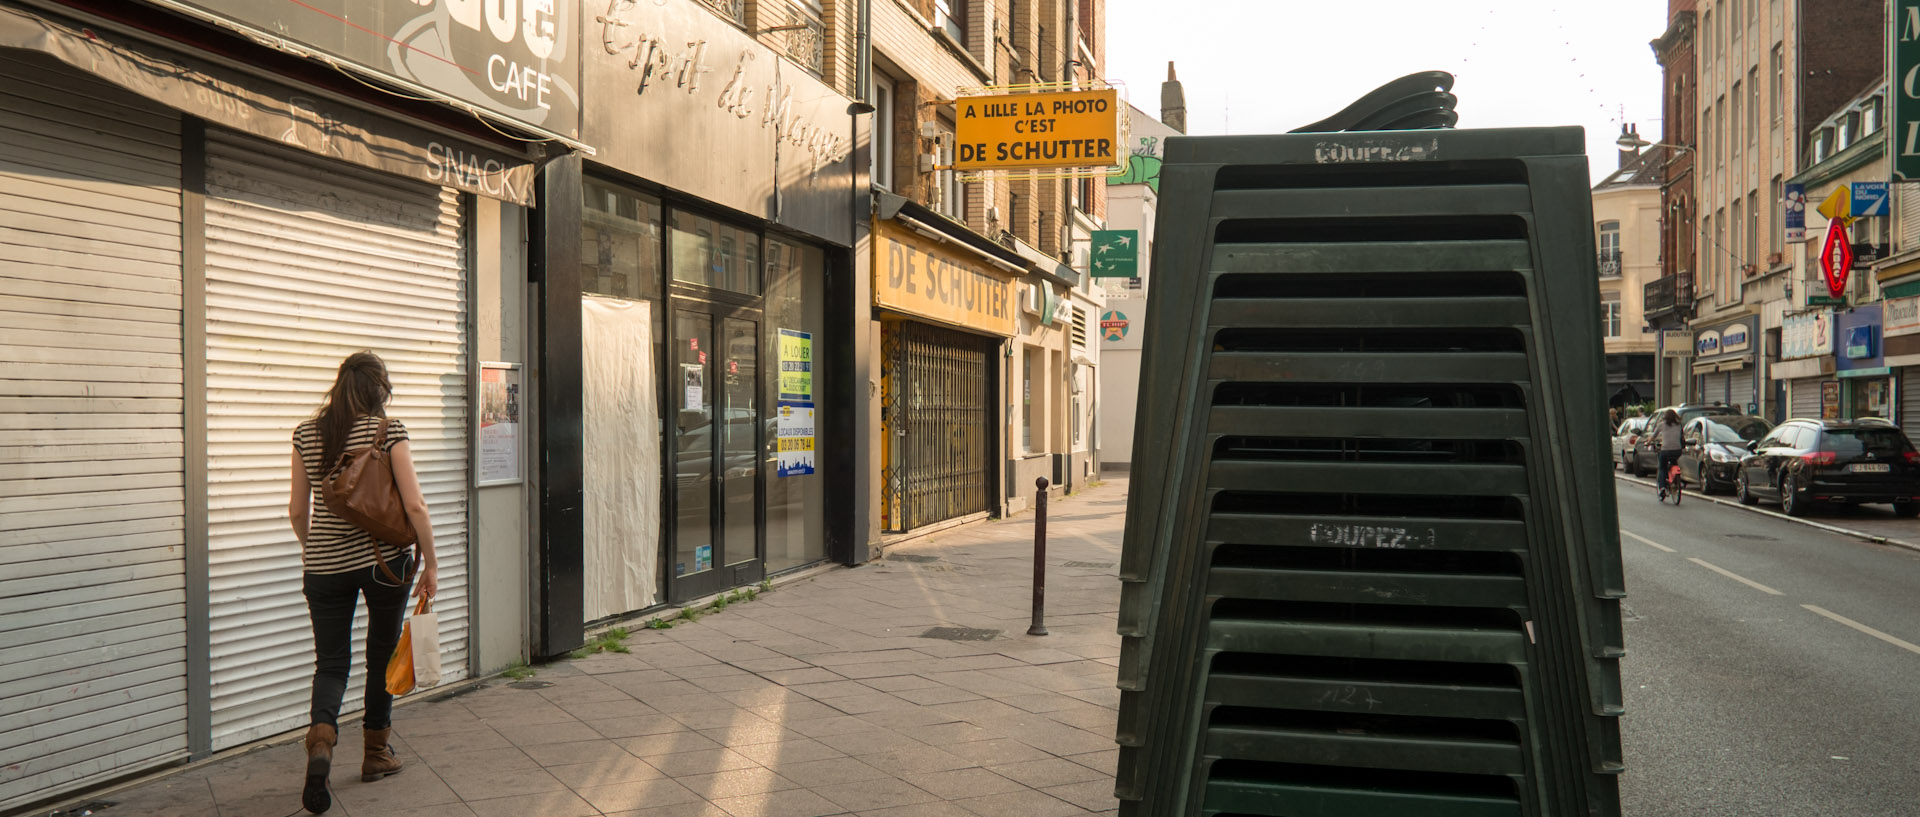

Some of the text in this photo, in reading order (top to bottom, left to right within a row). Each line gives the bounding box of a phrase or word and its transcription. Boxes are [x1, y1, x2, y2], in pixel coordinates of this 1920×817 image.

[487, 54, 552, 110] CAFE
[718, 49, 755, 119] de
[965, 98, 1108, 118] A LILLE LA PHOTO
[1015, 118, 1056, 134] C'EST
[960, 143, 987, 162] DE
[996, 138, 1112, 161] SCHUTTER
[426, 142, 518, 200] SNACK
[1832, 239, 1842, 278] TABAC
[888, 237, 1009, 321] DE SCHUTTER
[791, 346, 810, 360] LOUER
